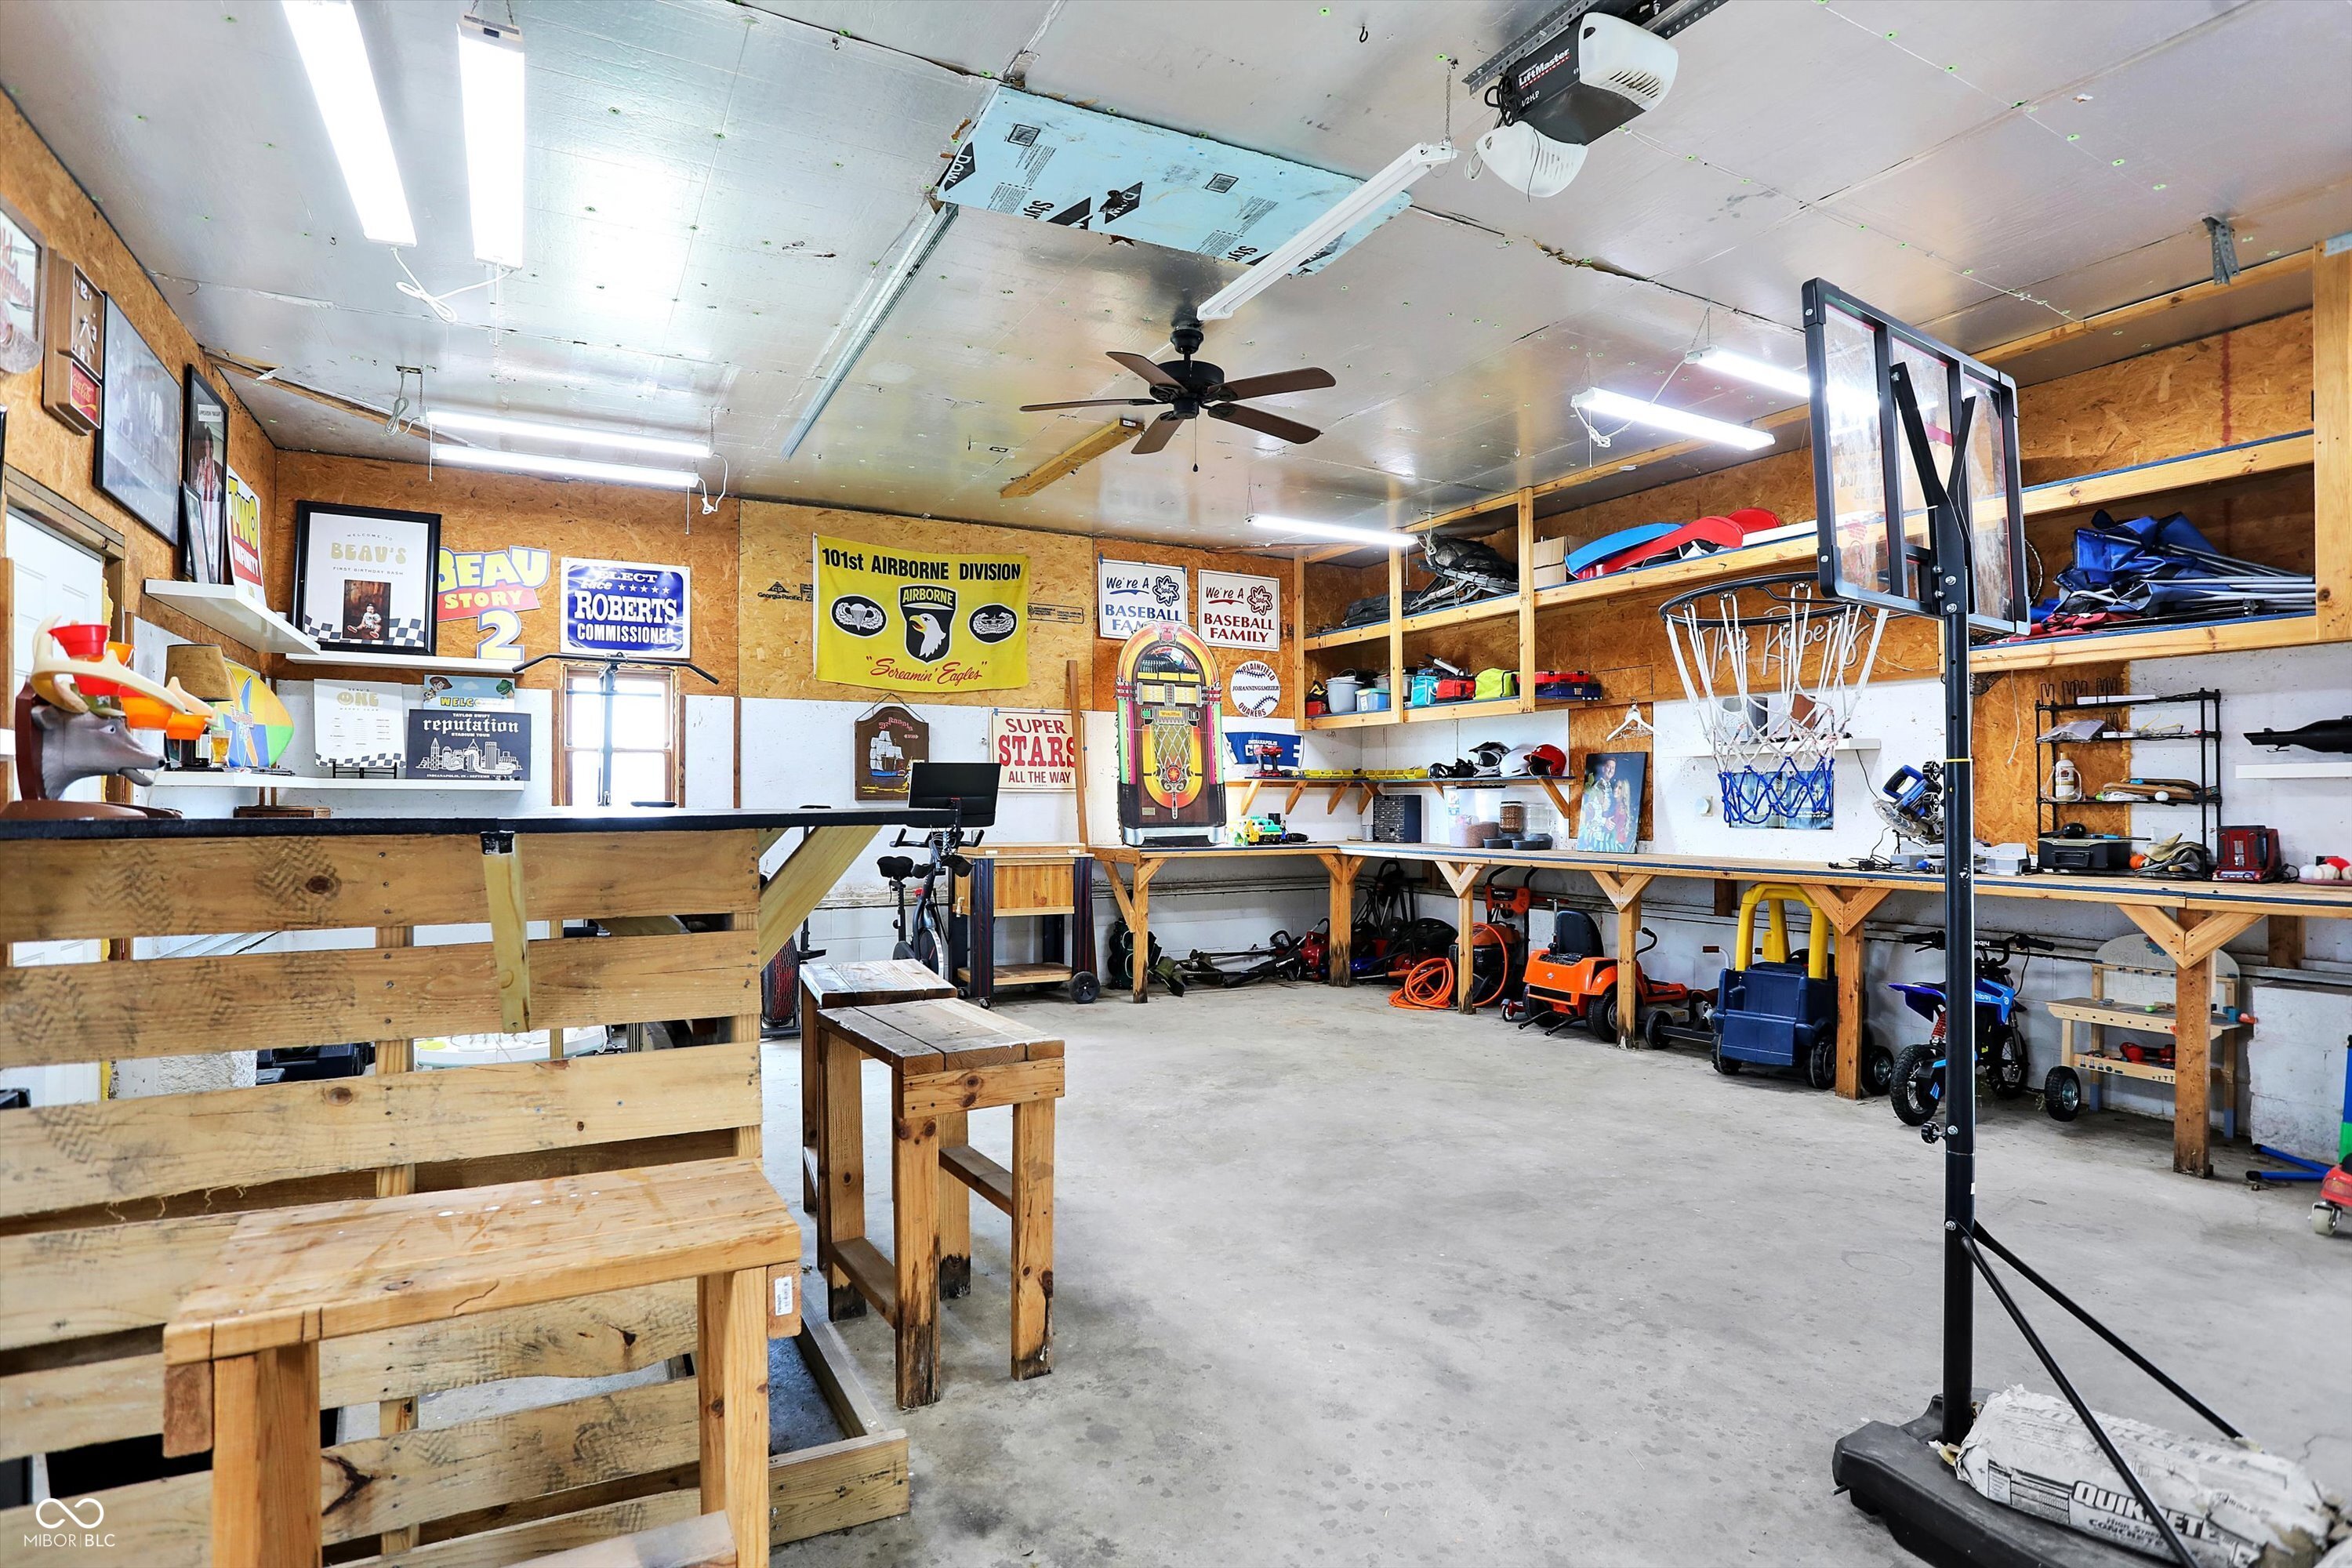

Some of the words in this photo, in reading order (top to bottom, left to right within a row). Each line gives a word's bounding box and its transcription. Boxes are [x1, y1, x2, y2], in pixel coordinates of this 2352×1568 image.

[228, 475, 259, 550] TWO
[331, 543, 407, 564] BEAU'S
[822, 548, 864, 571] 101st
[871, 555, 949, 579] AIRBORNE
[959, 563, 1021, 581] DIVISION
[1142, 579, 1149, 589] A
[444, 590, 523, 610] STORY
[902, 588, 953, 606] AIRBORNE
[1238, 590, 1244, 599] A
[574, 590, 677, 626] ROBERTS
[1105, 604, 1182, 622] BASEBALL
[1204, 613, 1275, 630] BASEBALL
[478, 608, 524, 661] 2
[577, 623, 676, 644] COMMISSIONER
[1210, 627, 1269, 643] FAMILY
[1243, 663, 1276, 681] PLAINFIELD
[1238, 702, 1267, 717] QUAKERS
[423, 717, 519, 735] reputation
[1005, 718, 1067, 734] SUPER
[998, 735, 1076, 768] STARS
[1008, 771, 1025, 783] ALL
[1028, 771, 1046, 783] THE
[1049, 771, 1071, 783] WAY
